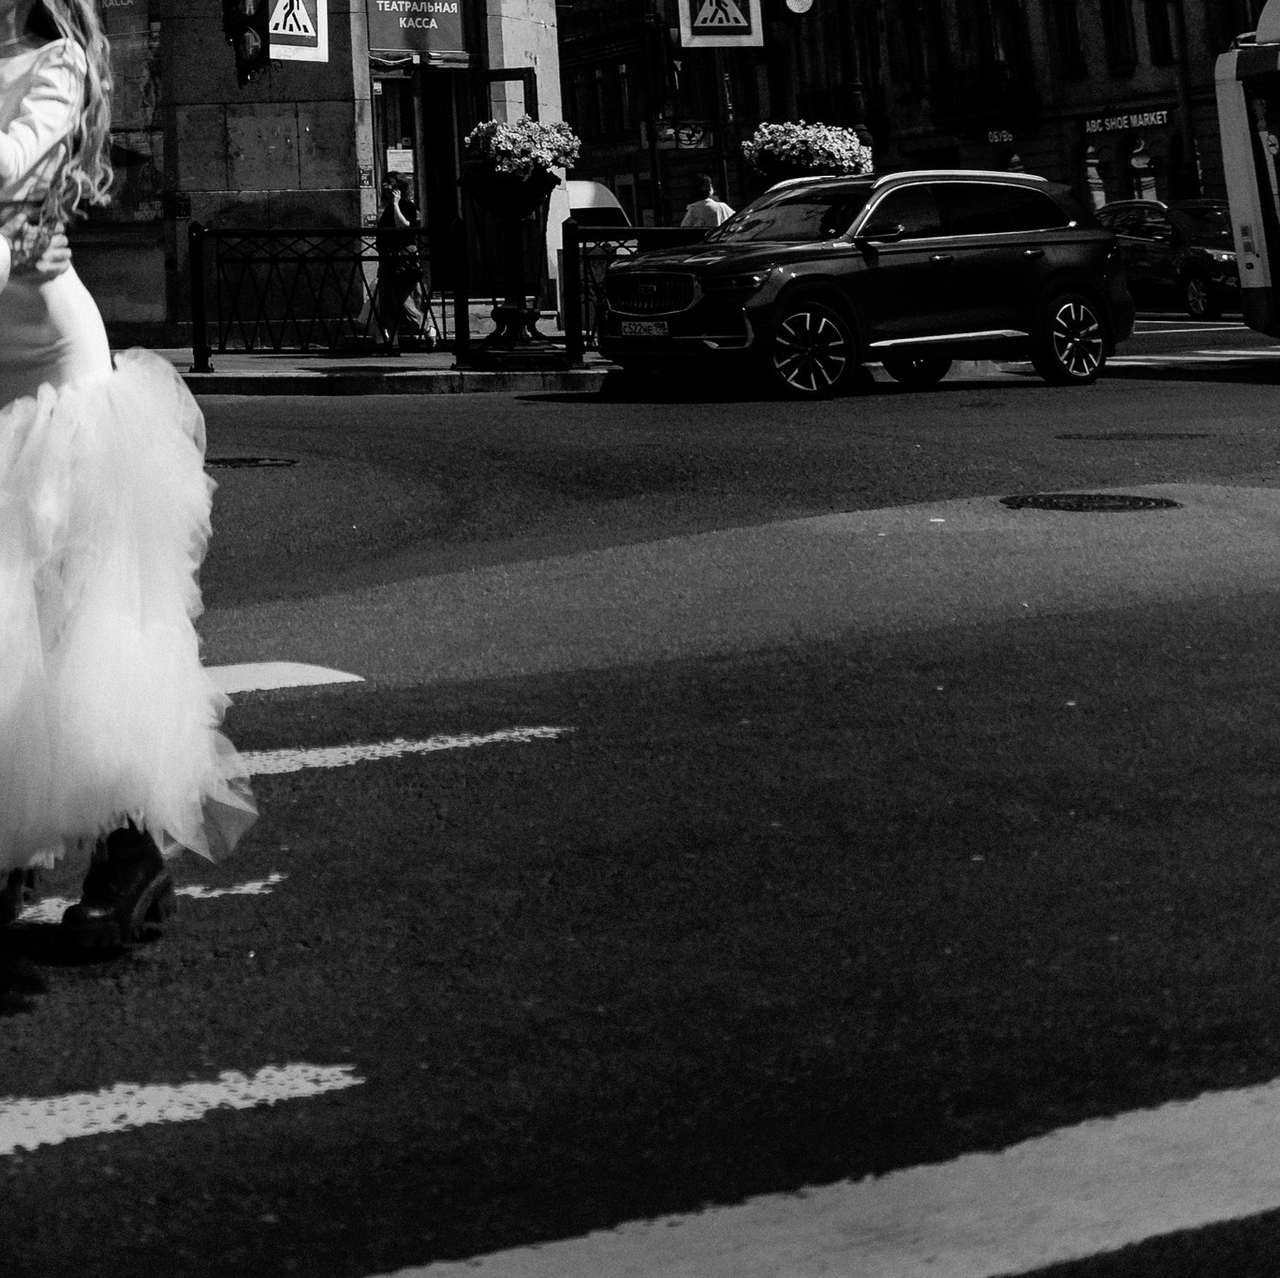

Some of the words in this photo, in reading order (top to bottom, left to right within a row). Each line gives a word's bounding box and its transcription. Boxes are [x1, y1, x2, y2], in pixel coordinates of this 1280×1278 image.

[376, 0, 458, 14] ТЕАТРАЛЬНАЯ
[399, 17, 438, 29] КАССА
[1086, 119, 1103, 133] ABC
[1105, 115, 1130, 131] SHOE
[1130, 110, 1168, 129] MARKET
